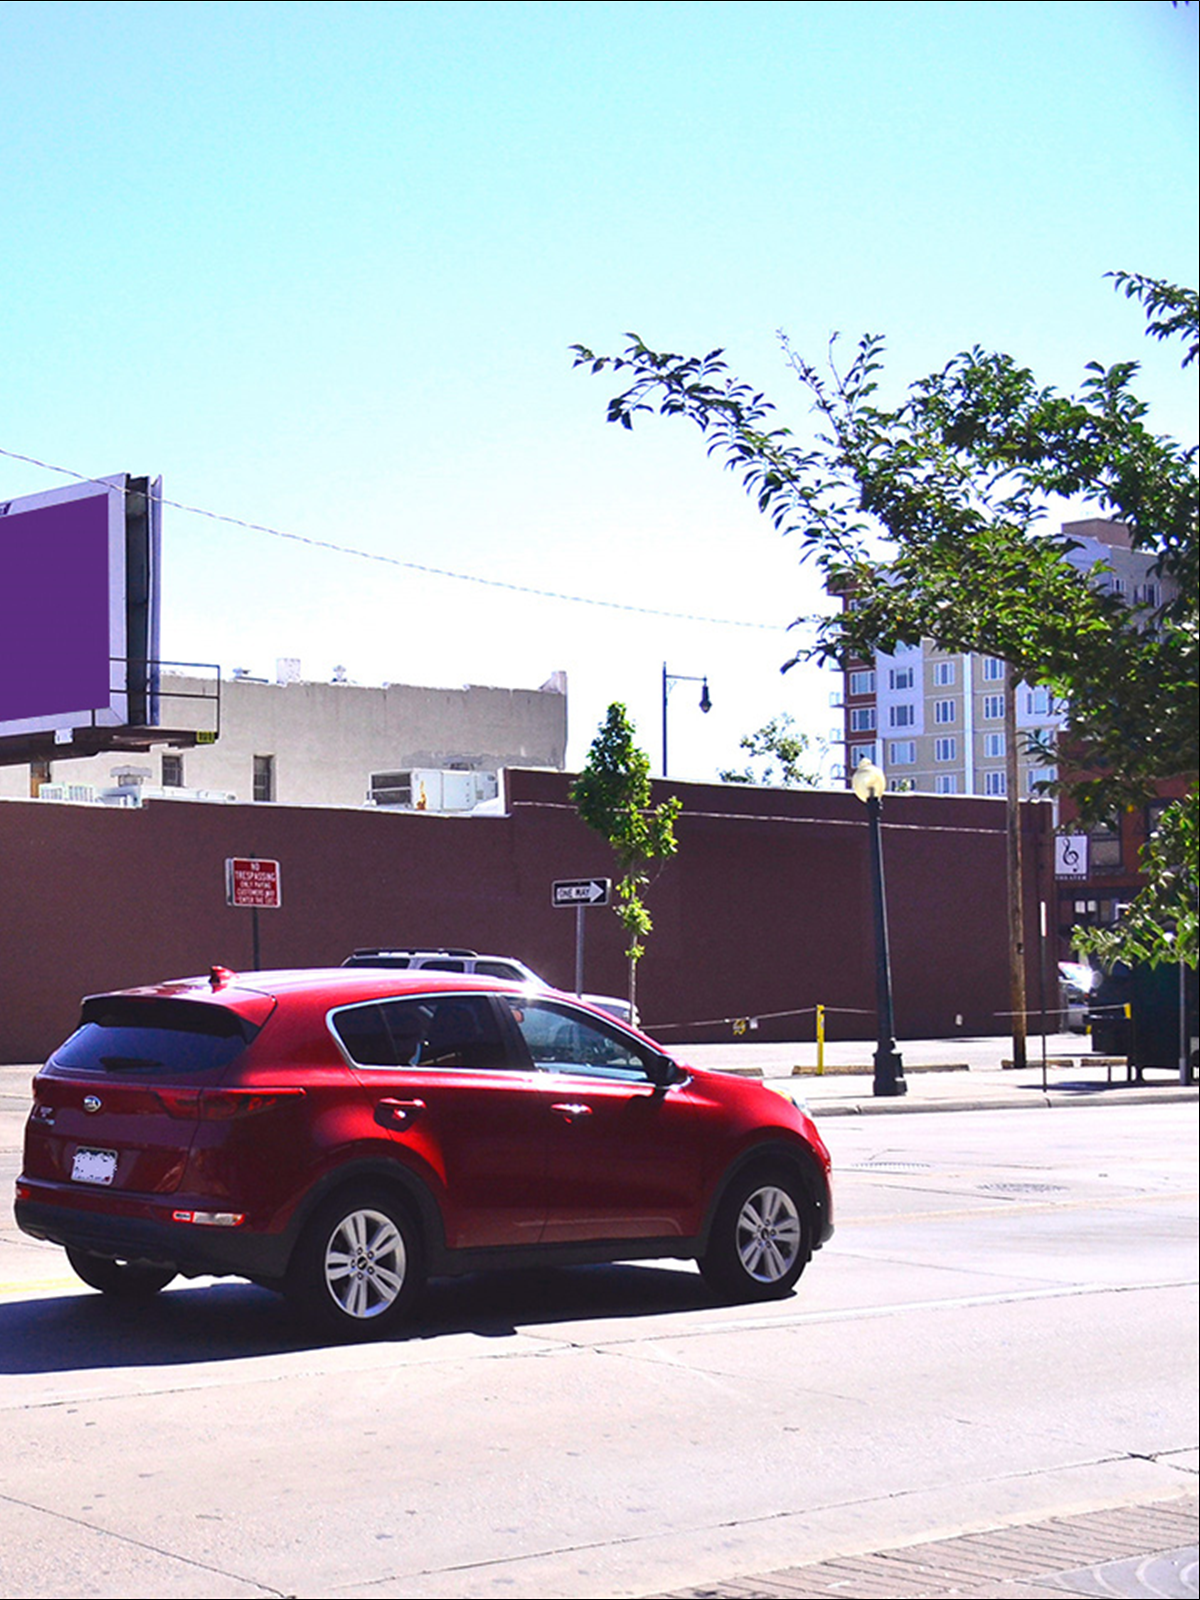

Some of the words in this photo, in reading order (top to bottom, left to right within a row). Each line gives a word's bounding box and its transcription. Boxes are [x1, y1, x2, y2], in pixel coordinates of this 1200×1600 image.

[251, 862, 260, 871] NO
[234, 871, 276, 882] TRESPASSING
[559, 887, 572, 898] ONE
[575, 887, 590, 897] WAY
